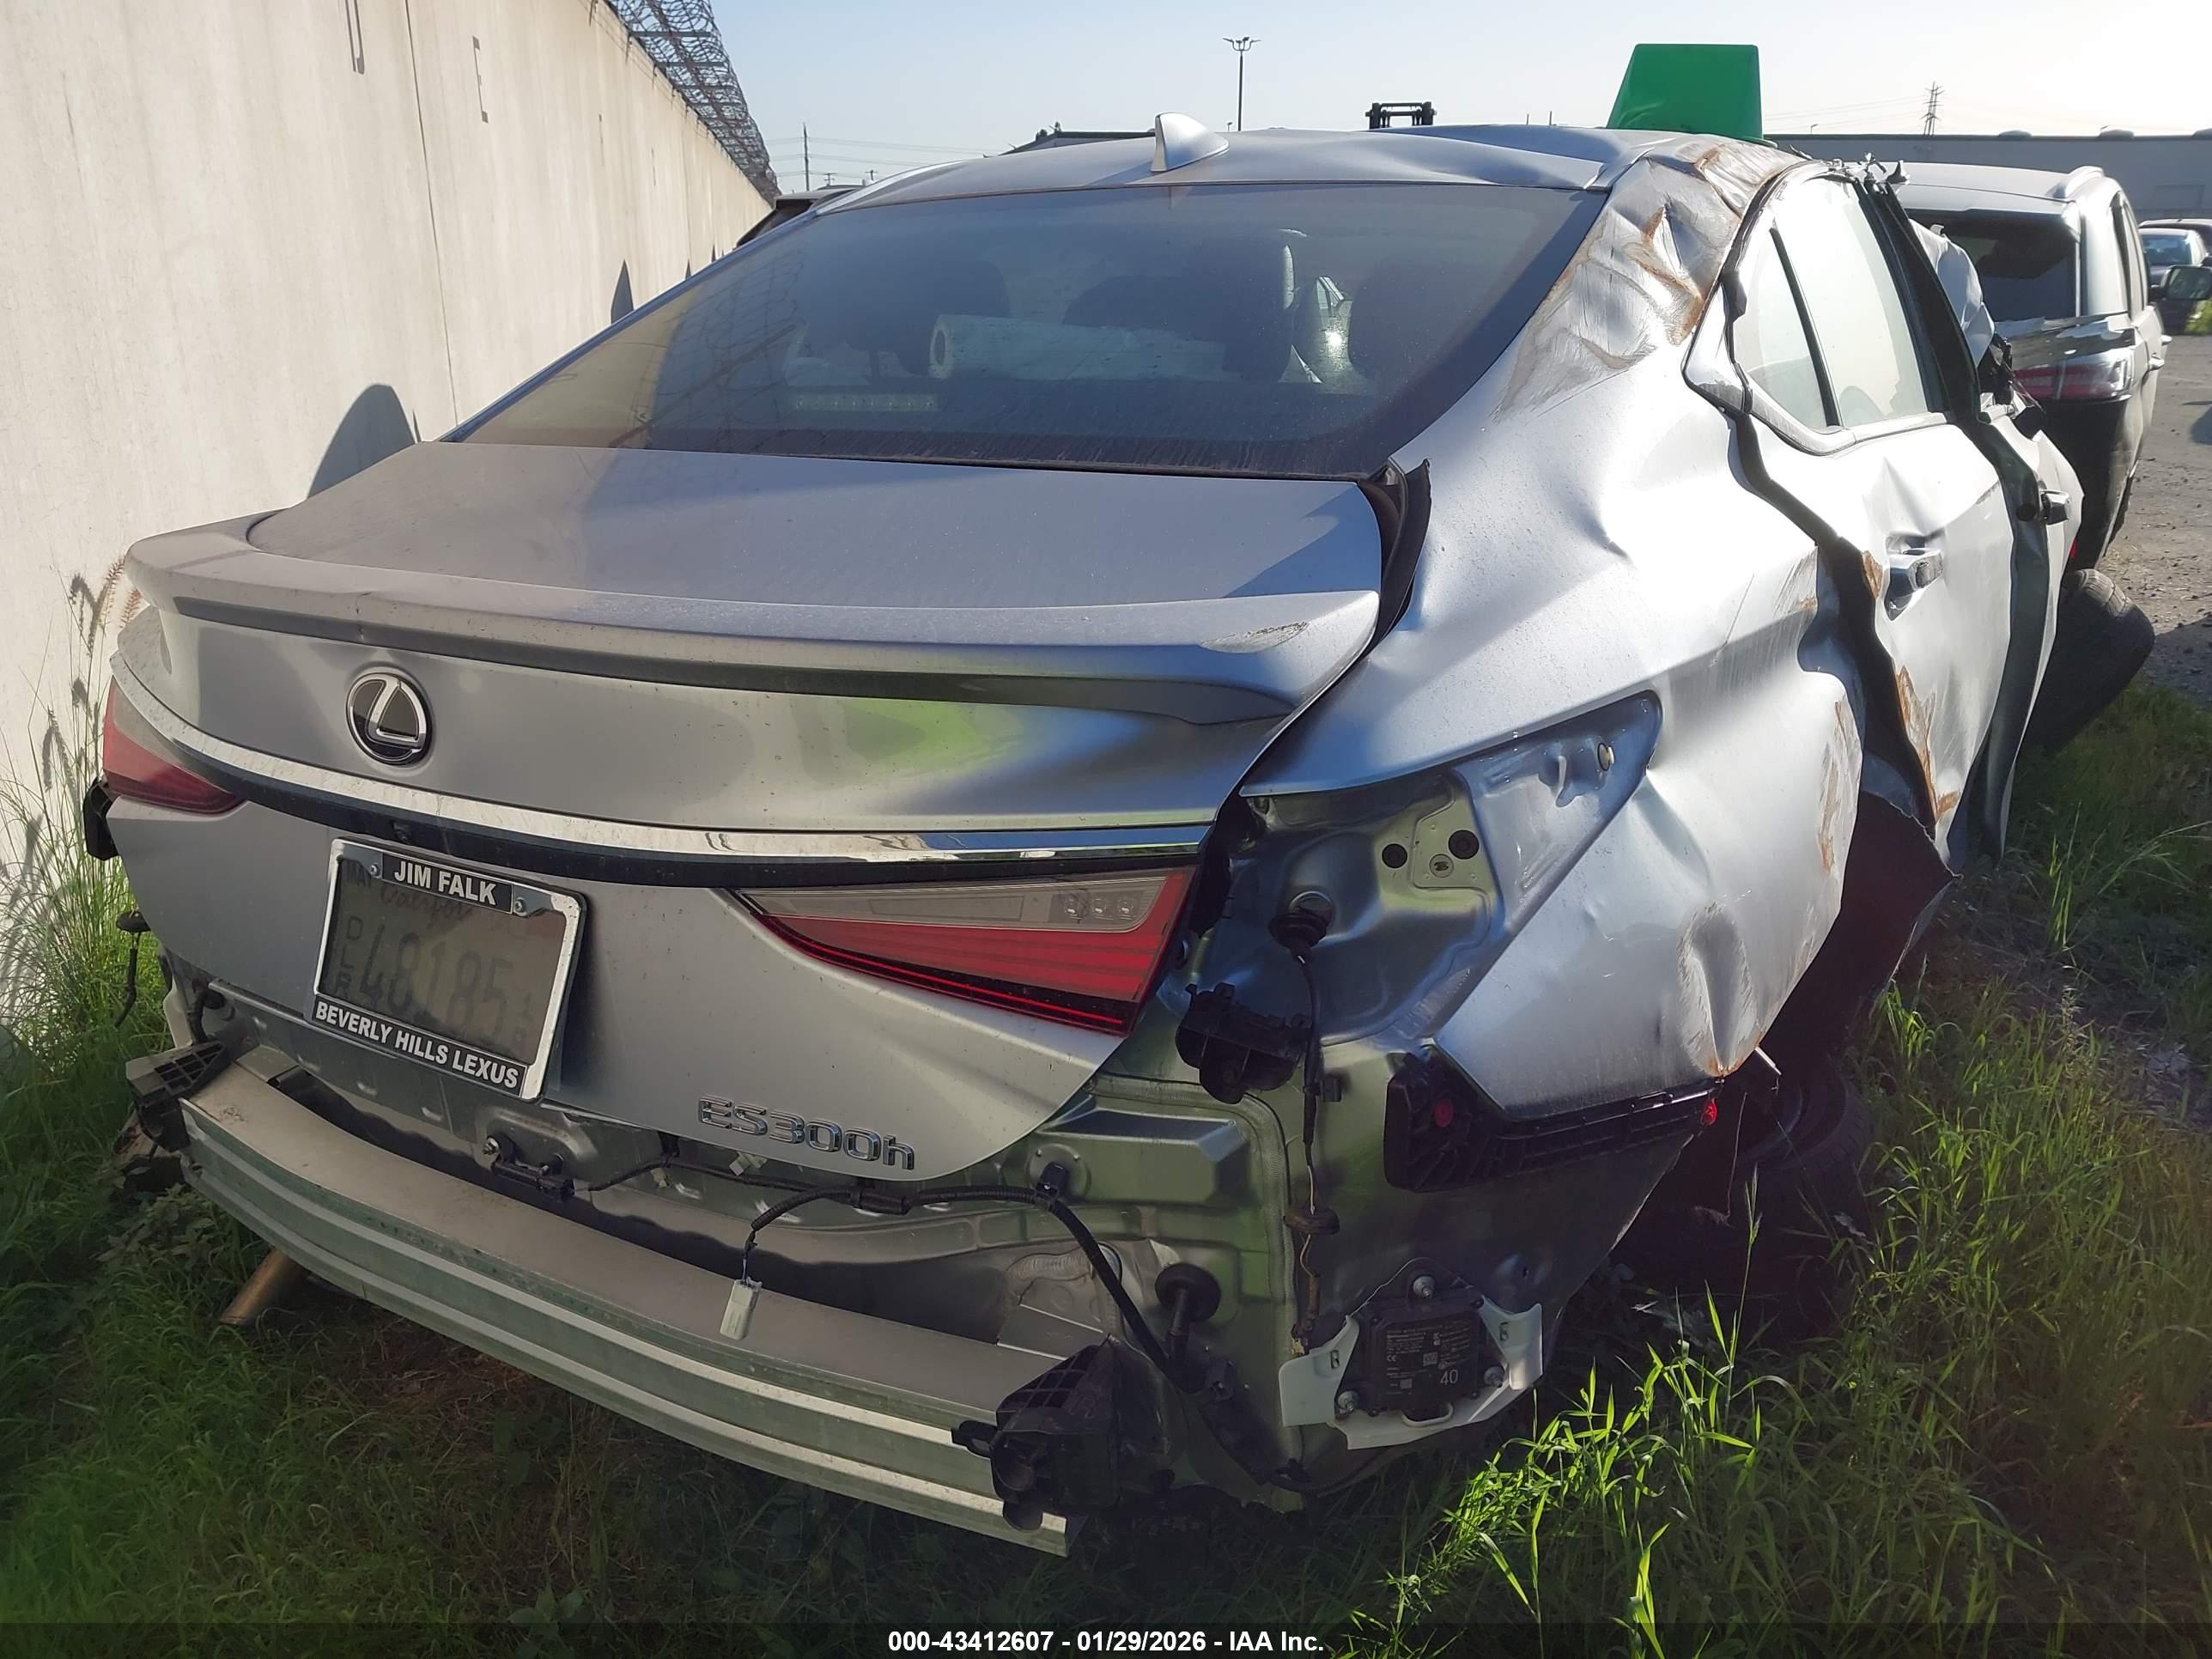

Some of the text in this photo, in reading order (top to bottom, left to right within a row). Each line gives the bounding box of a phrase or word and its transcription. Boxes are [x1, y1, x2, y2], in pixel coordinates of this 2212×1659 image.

[394, 860, 432, 890] JIM
[438, 869, 496, 905] FALK
[315, 1001, 519, 1089] BEVERLY HILLS LEXUS
[698, 1094, 915, 1170] ES300h
[1439, 1369, 1459, 1385] 40
